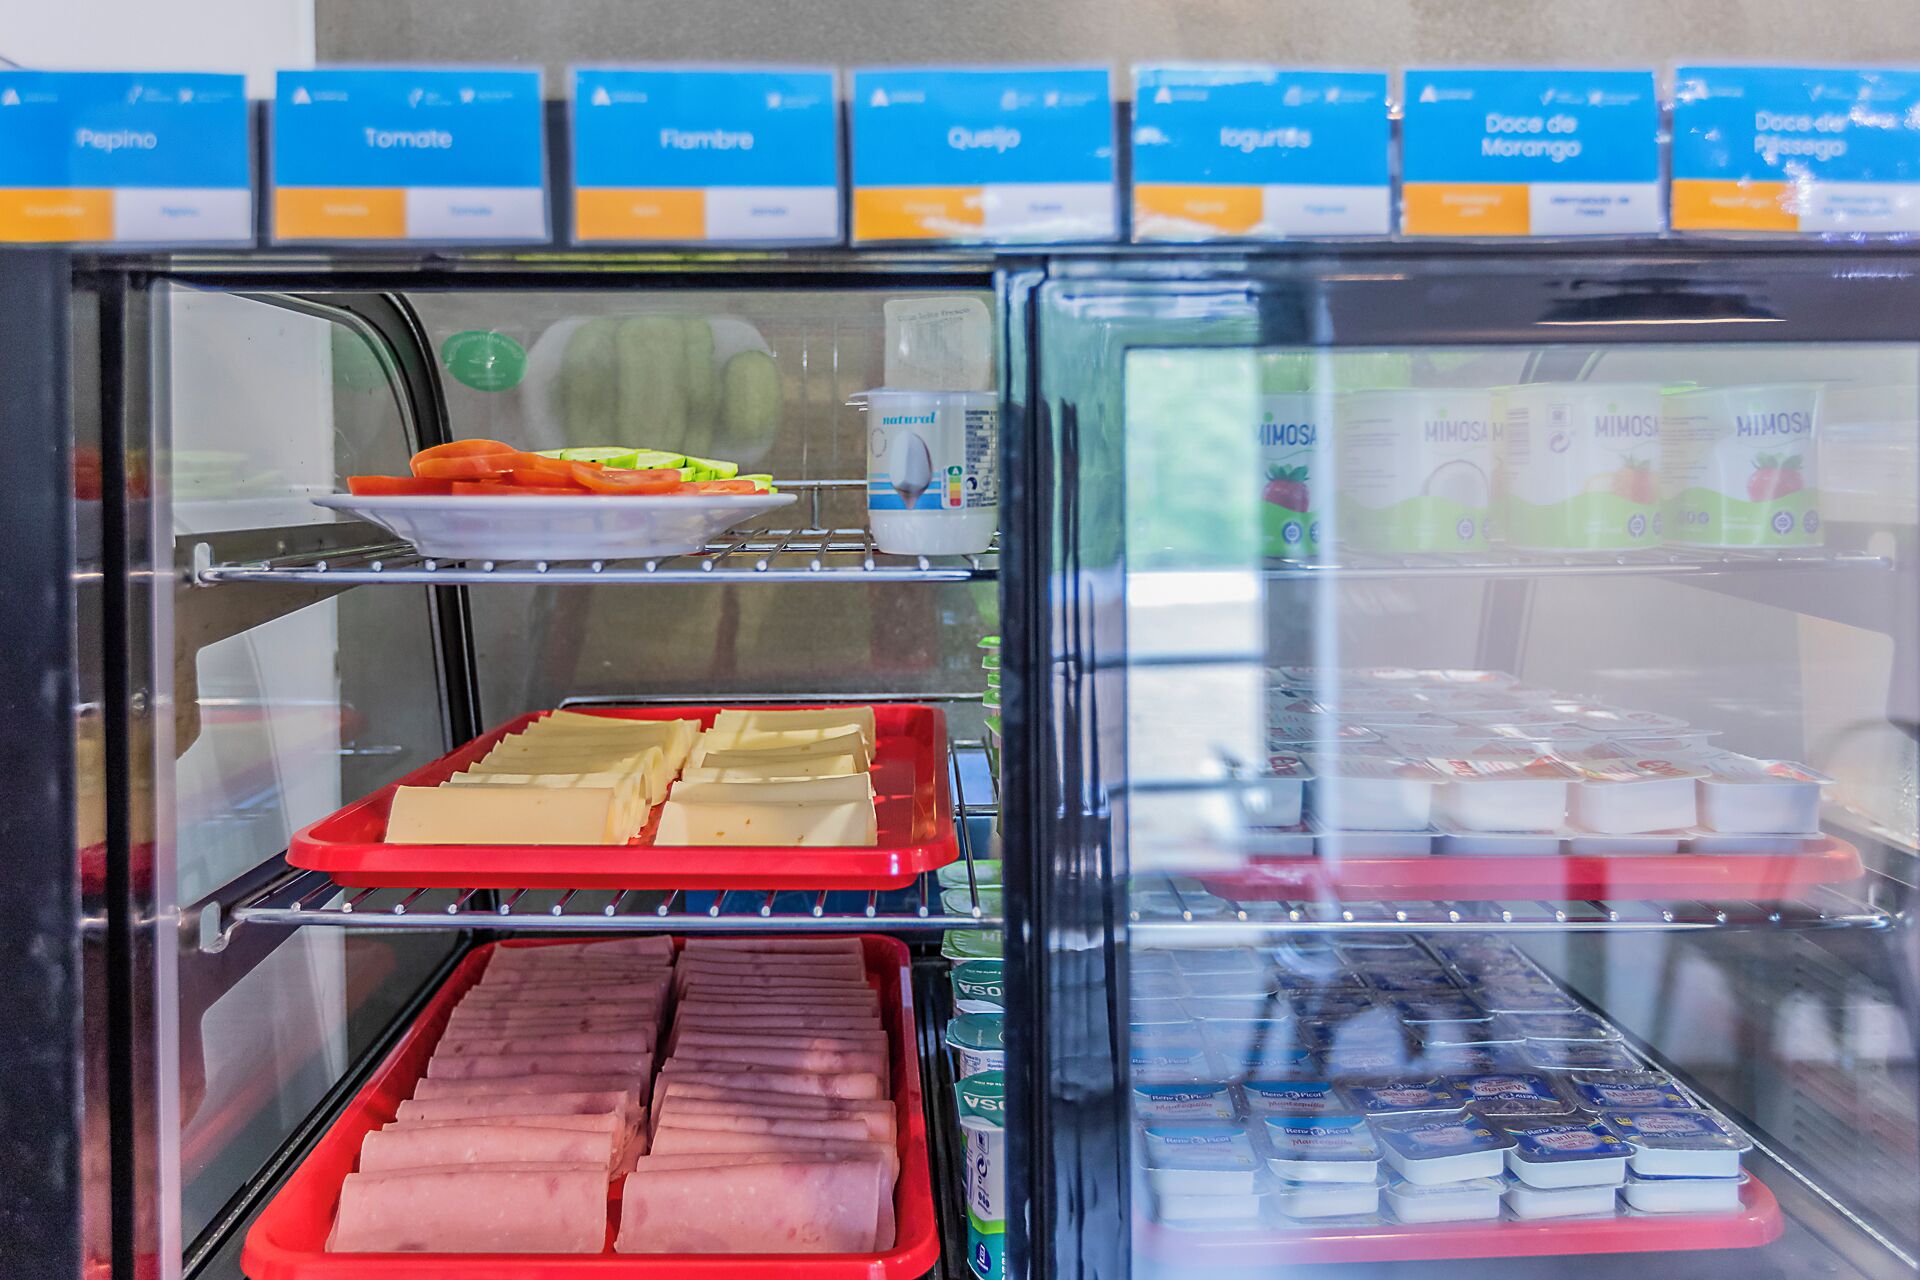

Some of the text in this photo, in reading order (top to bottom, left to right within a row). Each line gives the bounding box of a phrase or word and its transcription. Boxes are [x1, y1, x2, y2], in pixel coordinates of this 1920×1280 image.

[1485, 114, 1578, 133] Doce de
[1755, 111, 1811, 132] Doce
[76, 128, 157, 154] Pepino
[365, 127, 453, 149] Tomate
[660, 127, 754, 150] Fiambre
[947, 126, 1021, 153] Queijo
[1219, 126, 1312, 152] Iogurtes
[1481, 138, 1582, 163] Morango
[883, 411, 936, 425] natural
[1736, 411, 1811, 437] MIMOSA
